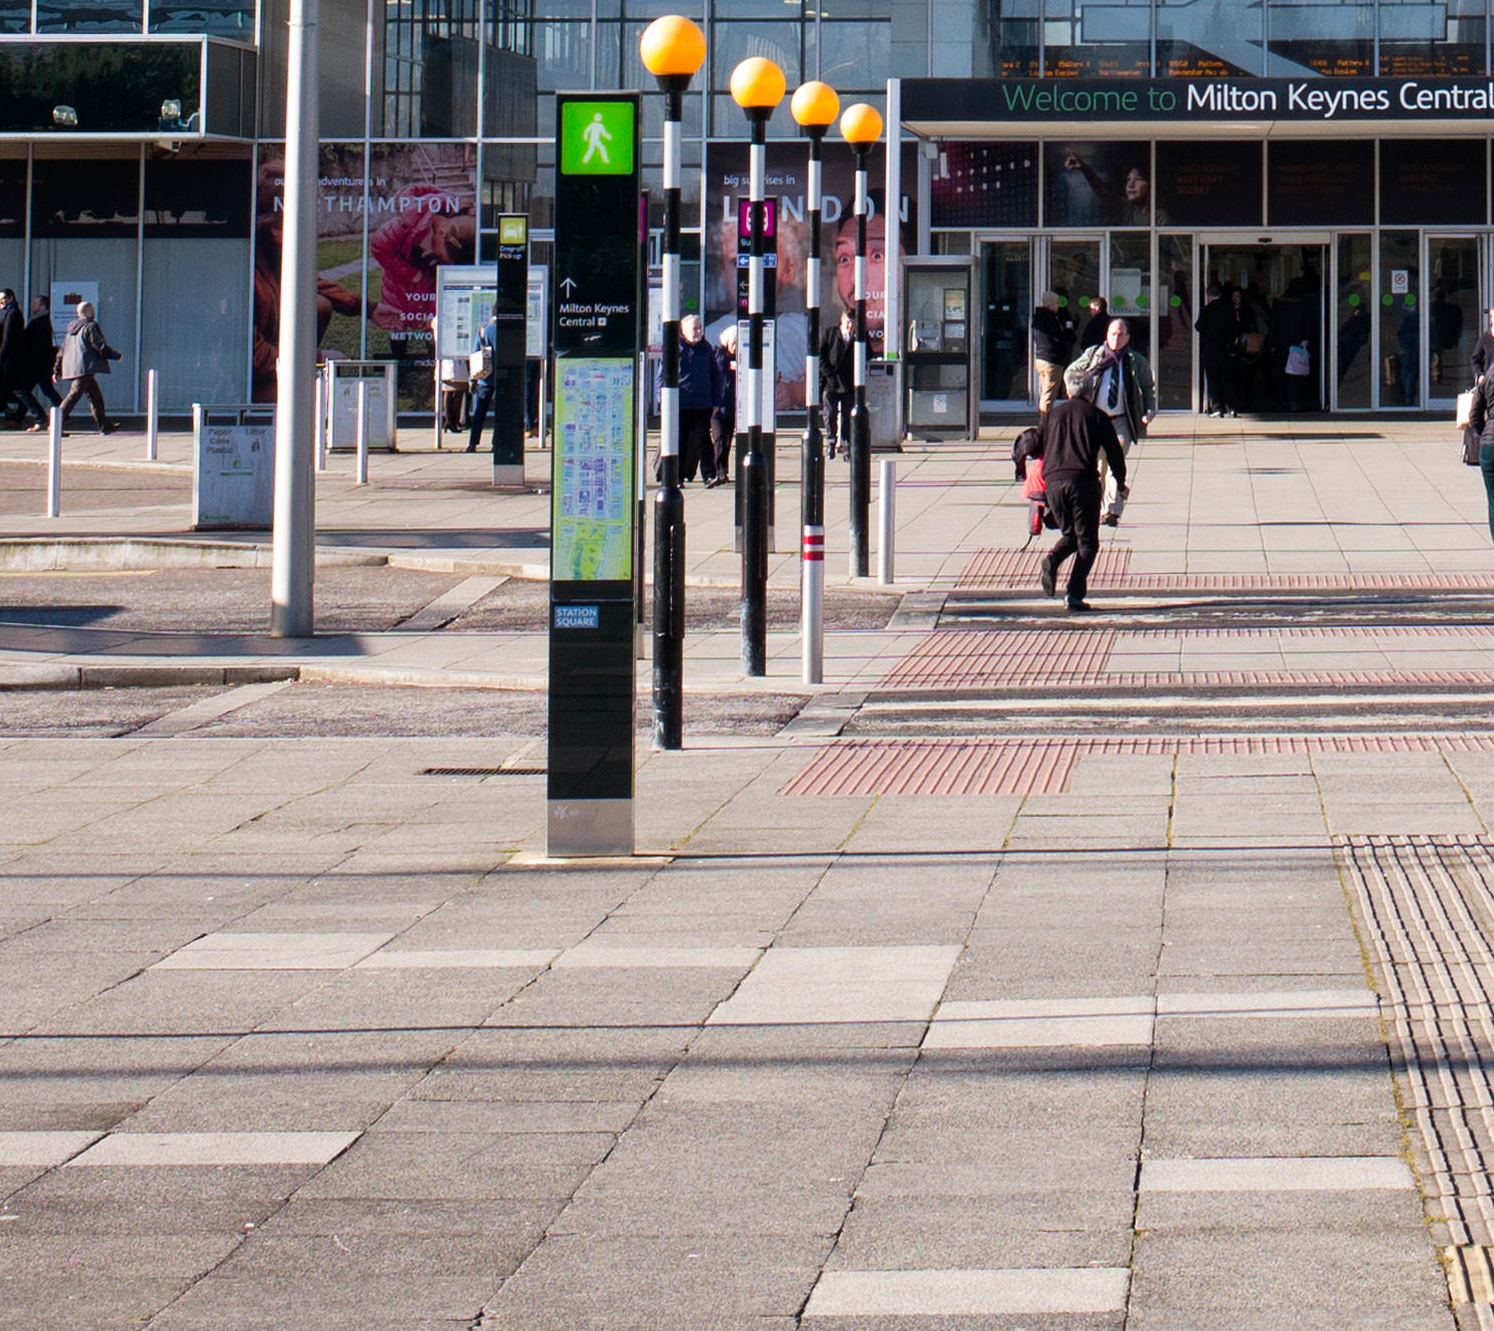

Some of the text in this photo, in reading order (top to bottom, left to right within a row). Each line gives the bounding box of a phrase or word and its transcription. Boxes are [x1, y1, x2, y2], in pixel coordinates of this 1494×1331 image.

[1002, 84, 1138, 111] Welcome
[1147, 86, 1177, 111] to
[1186, 83, 1277, 111] Milton
[1288, 83, 1389, 118] Keynes
[318, 176, 386, 186] dventures in
[723, 175, 796, 187] big suises in
[273, 196, 460, 212] NTHAMPTON
[723, 195, 909, 223] LNDO
[405, 292, 437, 301] YOUR
[559, 303, 629, 315] Milton Keynes
[399, 312, 434, 321] SOCIA
[559, 317, 595, 327] Central
[391, 332, 433, 341] NETWO
[556, 607, 597, 617] STATION
[556, 617, 595, 627] SQUARE
